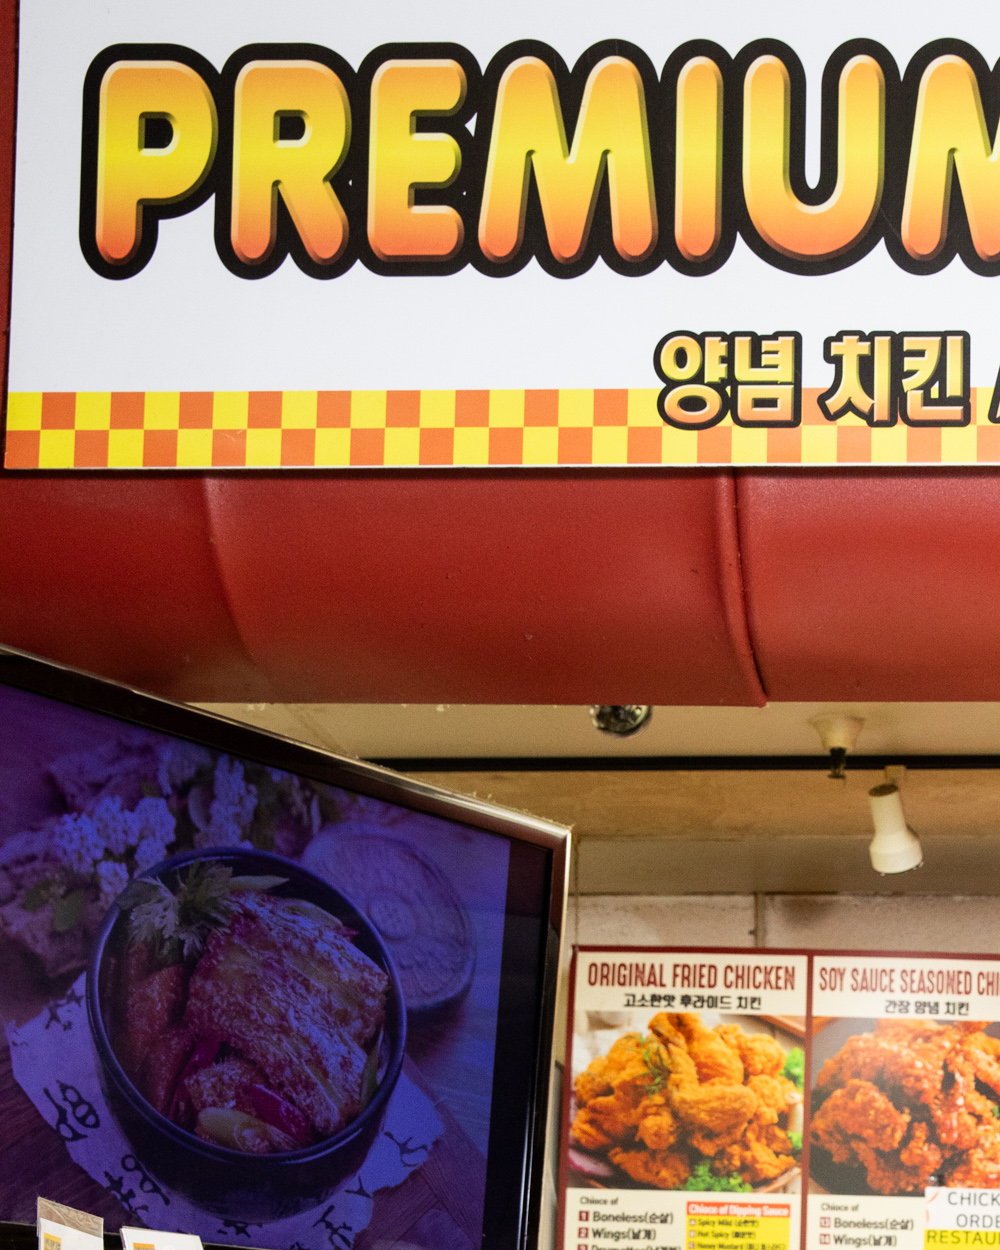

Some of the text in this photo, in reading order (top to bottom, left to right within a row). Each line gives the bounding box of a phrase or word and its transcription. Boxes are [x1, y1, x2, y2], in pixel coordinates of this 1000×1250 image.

[655, 330, 802, 427] 양념
[823, 330, 970, 427] 치킨
[588, 963, 795, 990] ORIGINAL FRIED CHICKEN
[820, 967, 846, 992] SOY
[851, 968, 895, 993] SAUCE
[900, 969, 972, 995] SEASONED
[680, 994, 732, 1010] 후라이드
[736, 995, 761, 1010] 치킨
[885, 1000, 969, 1016] 간장 양념 치킨
